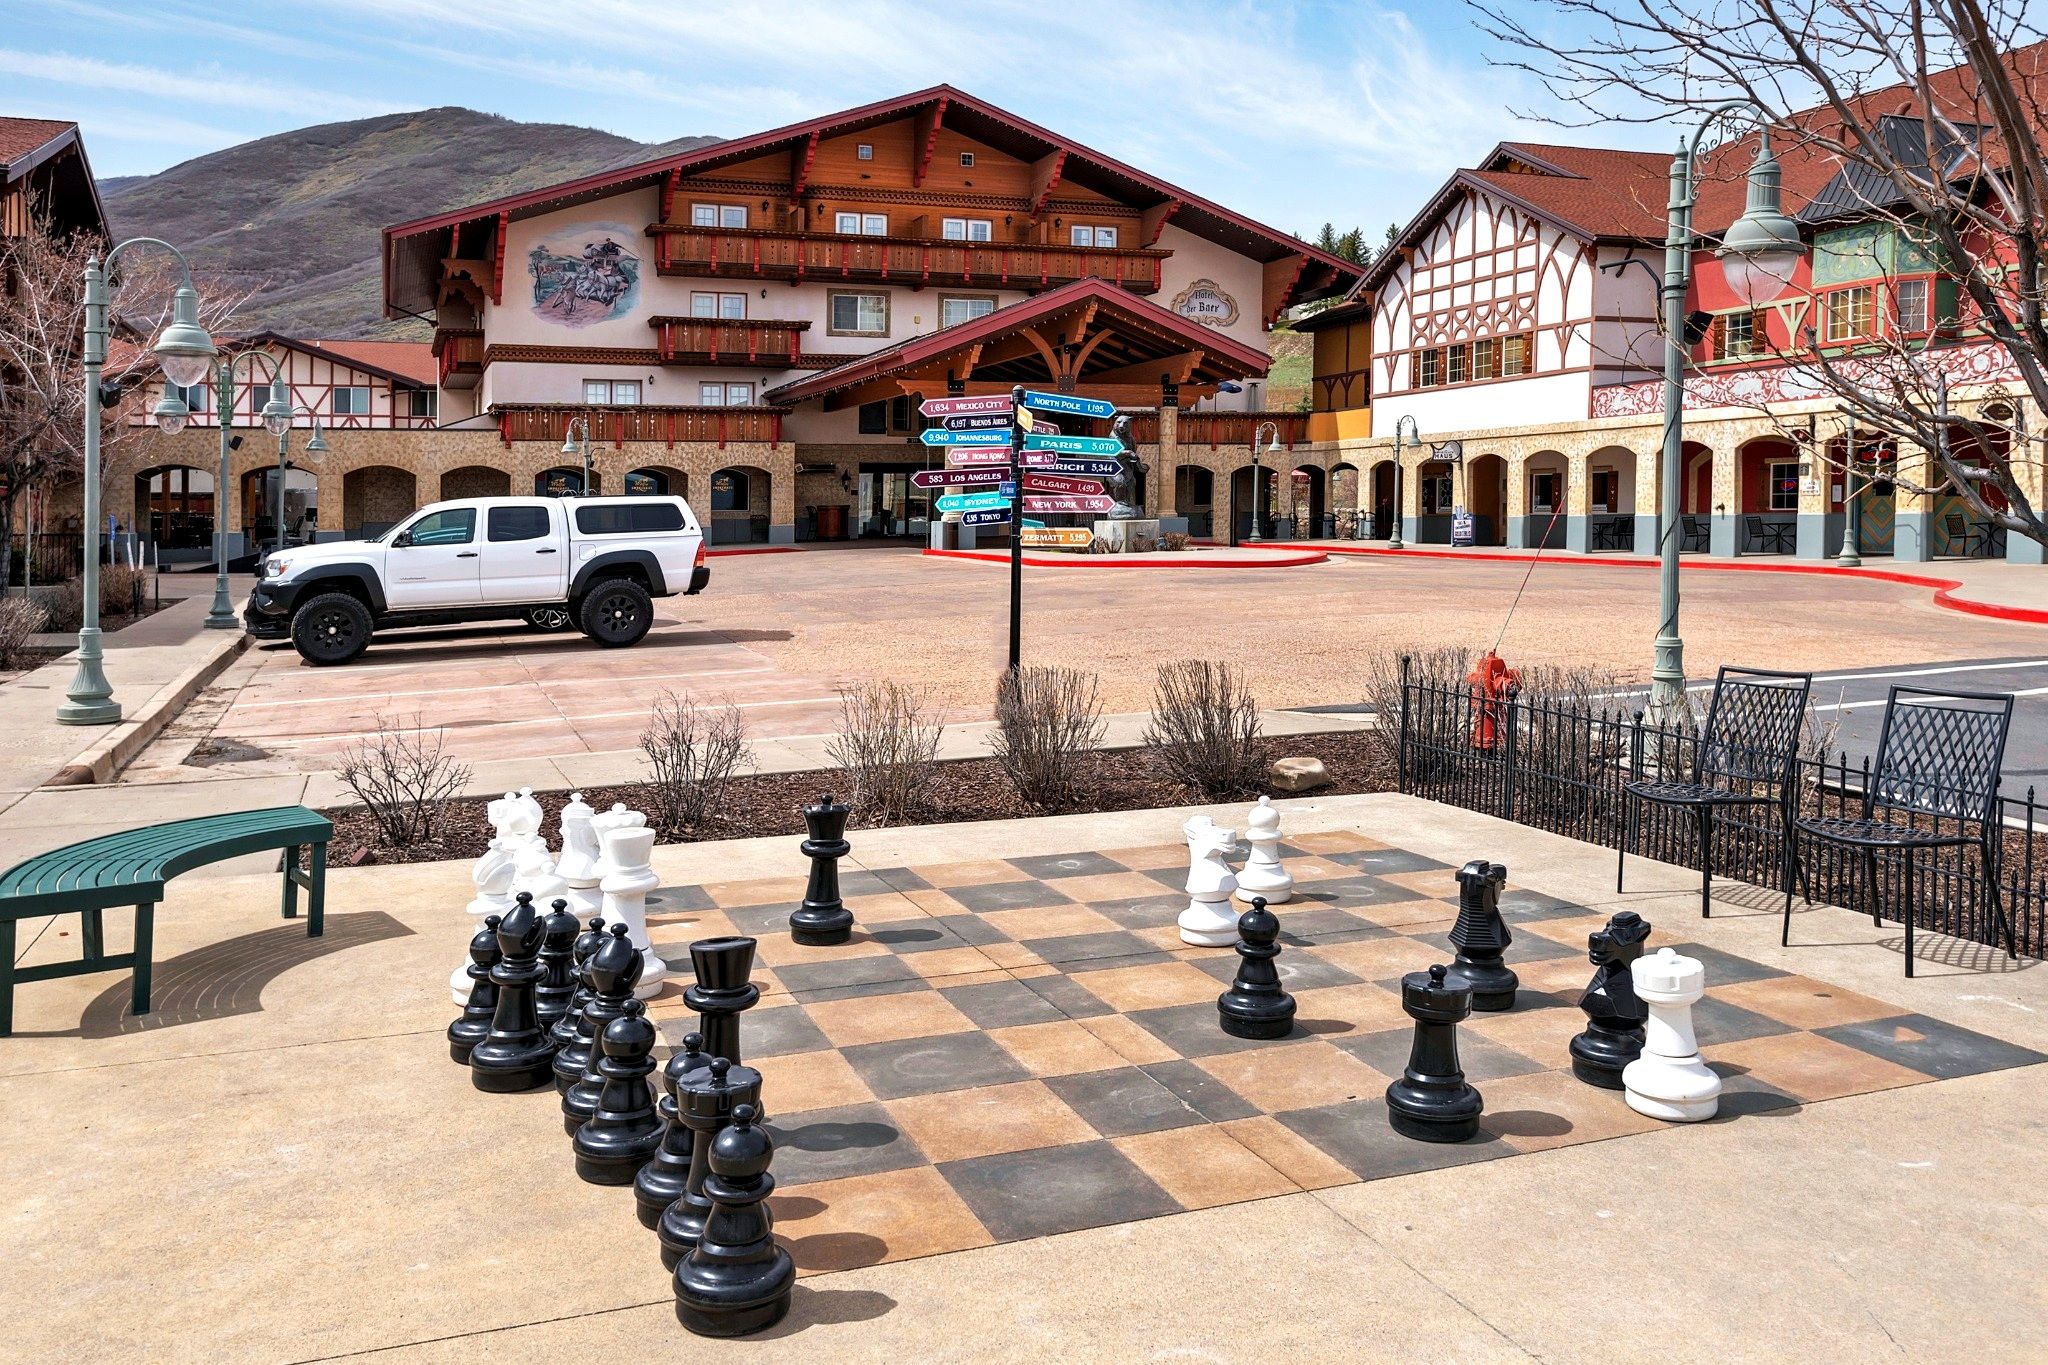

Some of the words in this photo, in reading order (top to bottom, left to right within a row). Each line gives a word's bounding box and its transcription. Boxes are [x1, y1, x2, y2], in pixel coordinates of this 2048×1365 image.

[1195, 291, 1213, 299] Hotel
[1187, 304, 1197, 313] der
[930, 403, 949, 413] 1,634
[956, 402, 984, 411] MEXICO
[985, 401, 1004, 409] CITY
[1034, 397, 1060, 407] NORTH
[1061, 402, 1081, 410] POLE
[970, 419, 991, 427] BUENOS
[928, 434, 949, 442] 9,940
[955, 434, 1003, 442] JOHANNESBURG
[1040, 441, 1082, 449] PARIS
[1091, 443, 1115, 452] 5,070
[989, 452, 1005, 461] KONG
[1026, 455, 1043, 465] ROME
[1091, 464, 1113, 473] 5,344
[928, 475, 943, 483] 583
[968, 473, 1001, 481] ANGELES
[1031, 478, 1071, 490] CALGARY
[965, 498, 999, 506] SYDNEY
[1032, 501, 1052, 509] NEW
[1054, 501, 1077, 509] YORK
[1023, 534, 1064, 542] ZERMATT
